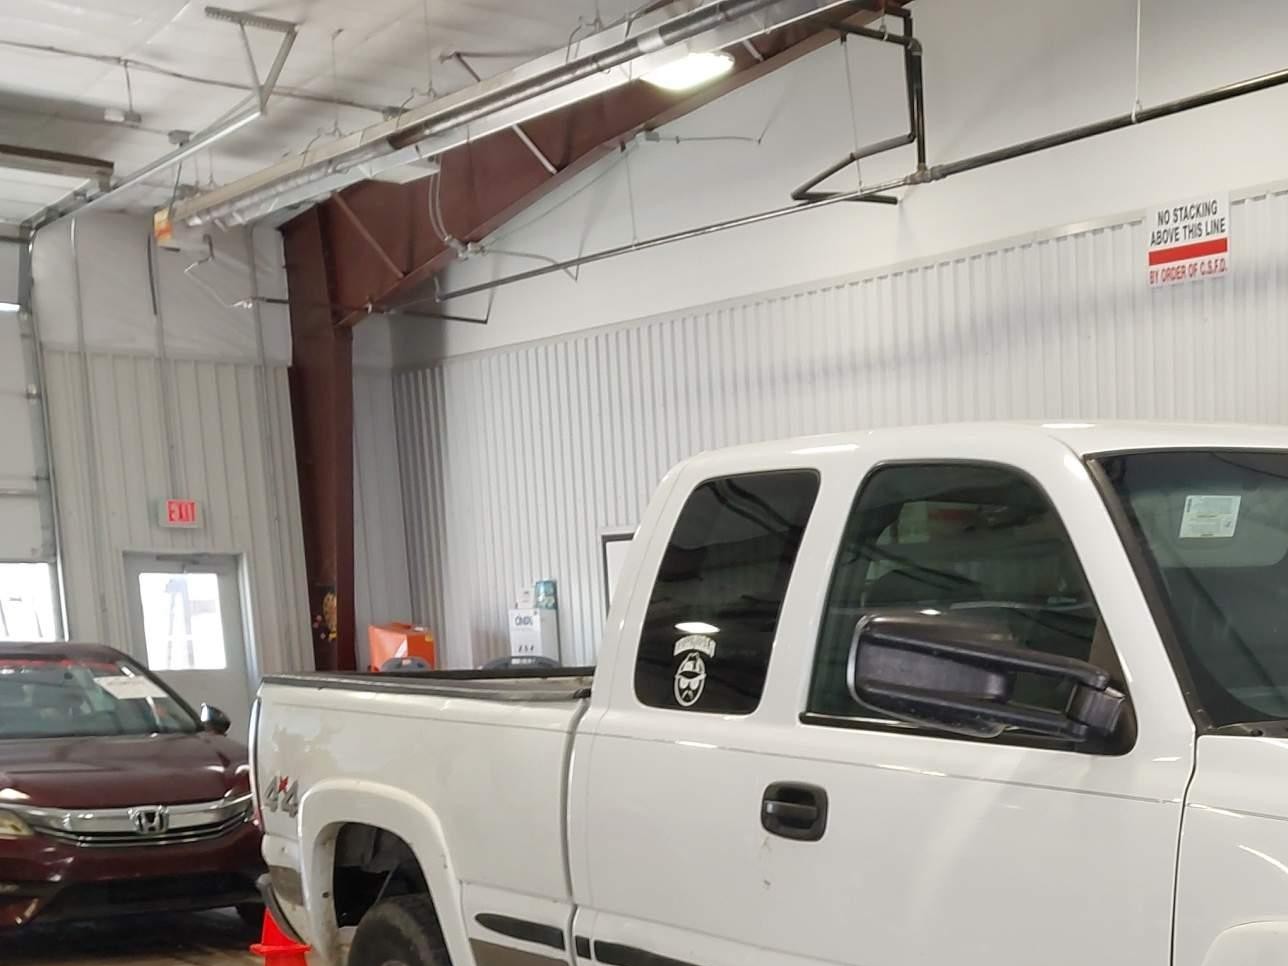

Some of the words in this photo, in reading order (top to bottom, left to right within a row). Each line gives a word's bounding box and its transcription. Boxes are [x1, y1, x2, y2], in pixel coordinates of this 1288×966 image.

[1158, 209, 1170, 226] NO
[1173, 200, 1218, 223] STACKING
[1150, 227, 1179, 246] ABOVE
[1182, 222, 1202, 240] THIS
[1205, 217, 1225, 236] LINE
[1150, 269, 1159, 284] BY
[1161, 265, 1186, 282] ORDER
[1188, 263, 1198, 278] OF
[167, 500, 196, 521] EXIT
